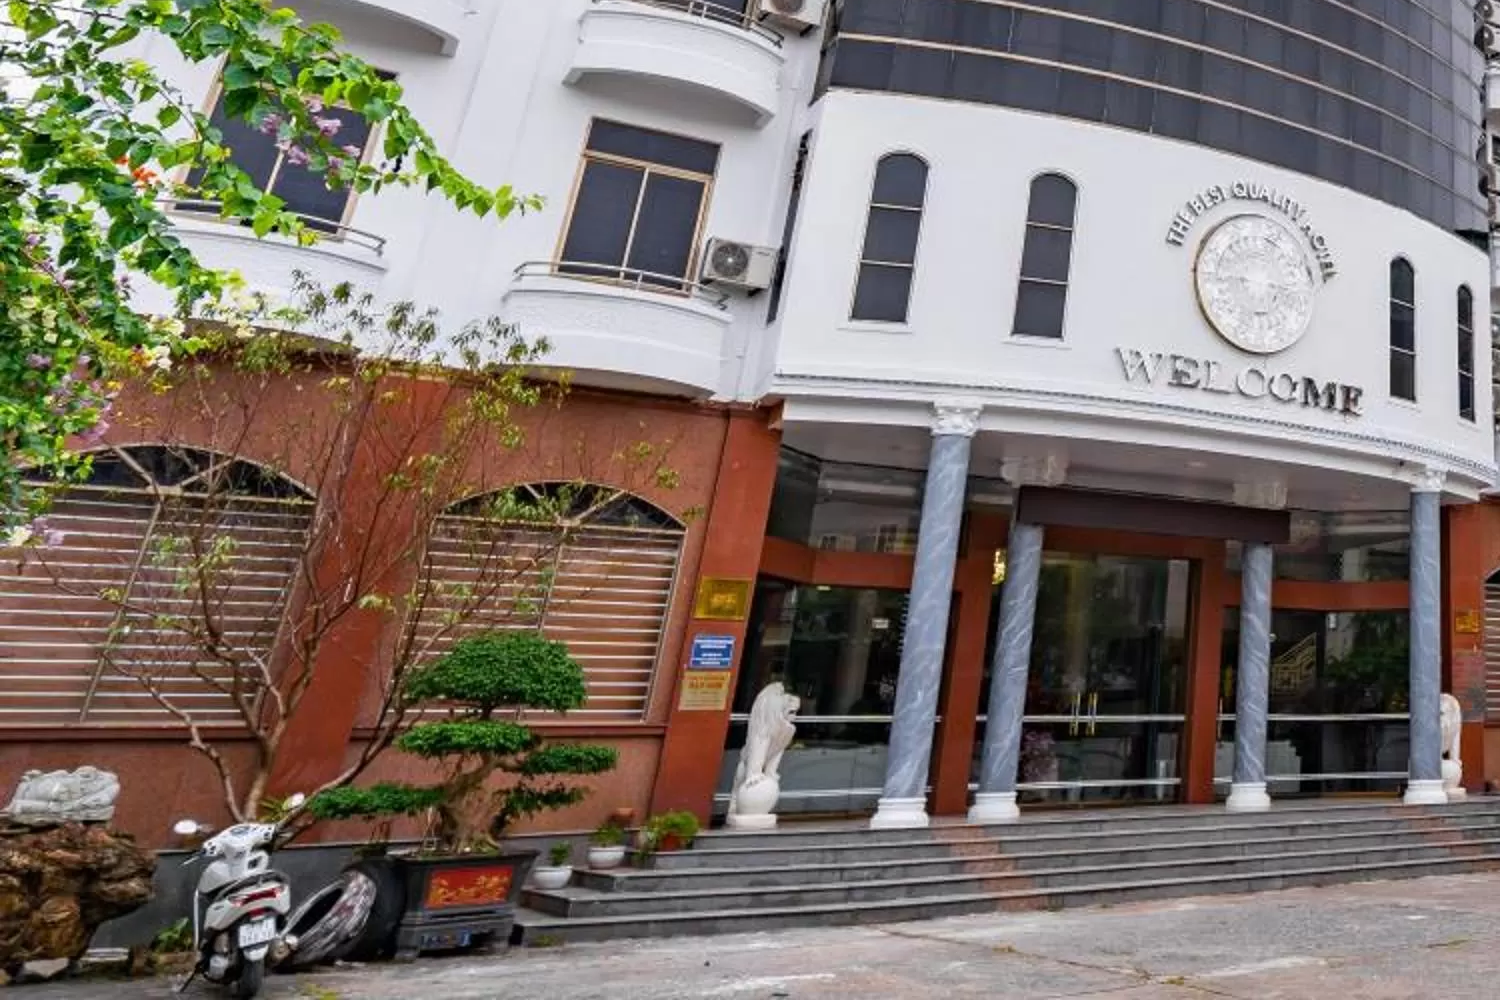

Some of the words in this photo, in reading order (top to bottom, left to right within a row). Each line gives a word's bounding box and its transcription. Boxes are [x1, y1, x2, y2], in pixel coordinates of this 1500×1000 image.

[1165, 211, 1196, 247] THE
[1186, 184, 1229, 216] BEST
[1230, 179, 1307, 222] QUALITY
[1115, 347, 1364, 417] WELCOME
